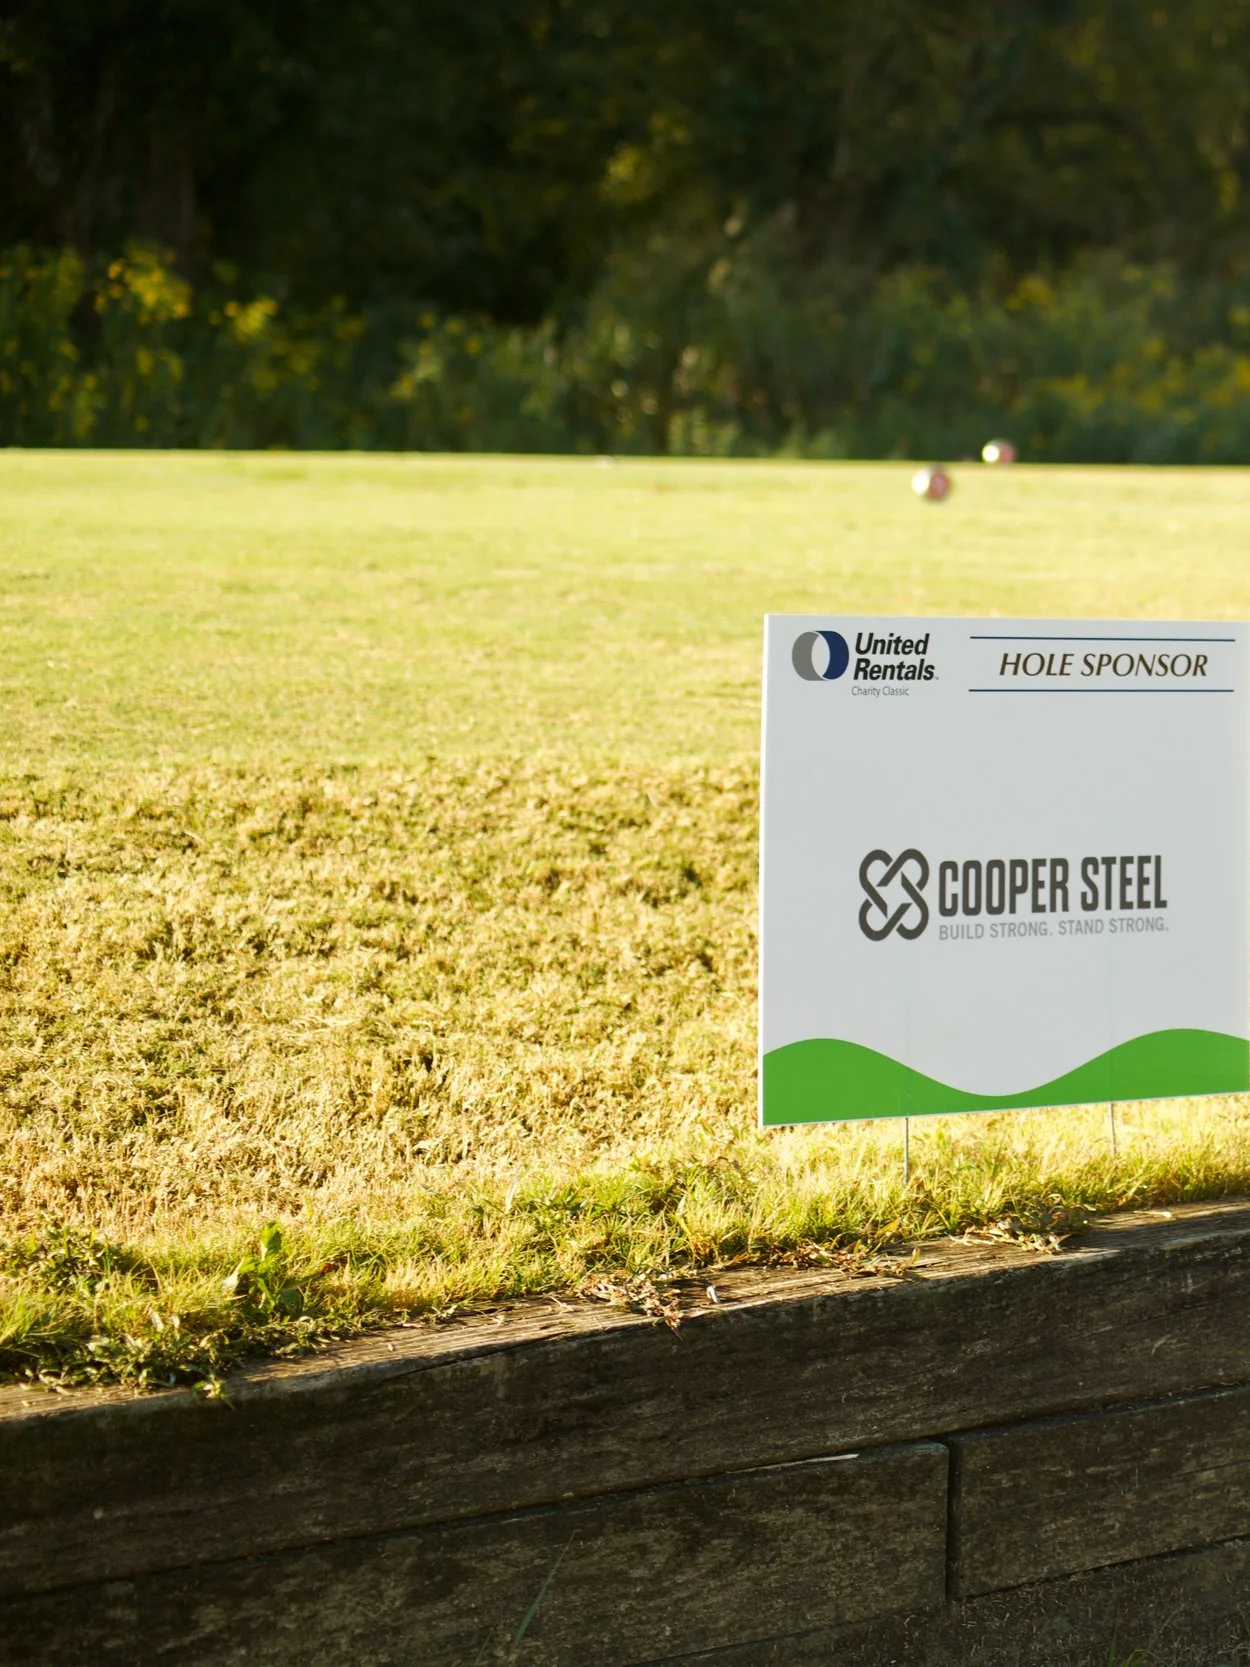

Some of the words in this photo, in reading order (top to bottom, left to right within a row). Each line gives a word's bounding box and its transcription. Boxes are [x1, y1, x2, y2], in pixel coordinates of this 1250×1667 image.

[855, 632, 930, 655] United
[853, 658, 935, 681] Rentals
[999, 653, 1074, 676] HOLE
[1081, 653, 1208, 677] SPONSOR
[851, 685, 881, 698] Charity
[882, 685, 909, 696] Classic
[939, 857, 1069, 917] COOPER
[1080, 855, 1168, 912] STEEL
[939, 924, 984, 940] BUILD
[990, 921, 1052, 938] STRONG.
[1058, 918, 1104, 935] STAND
[1108, 916, 1169, 933] STRONG.
